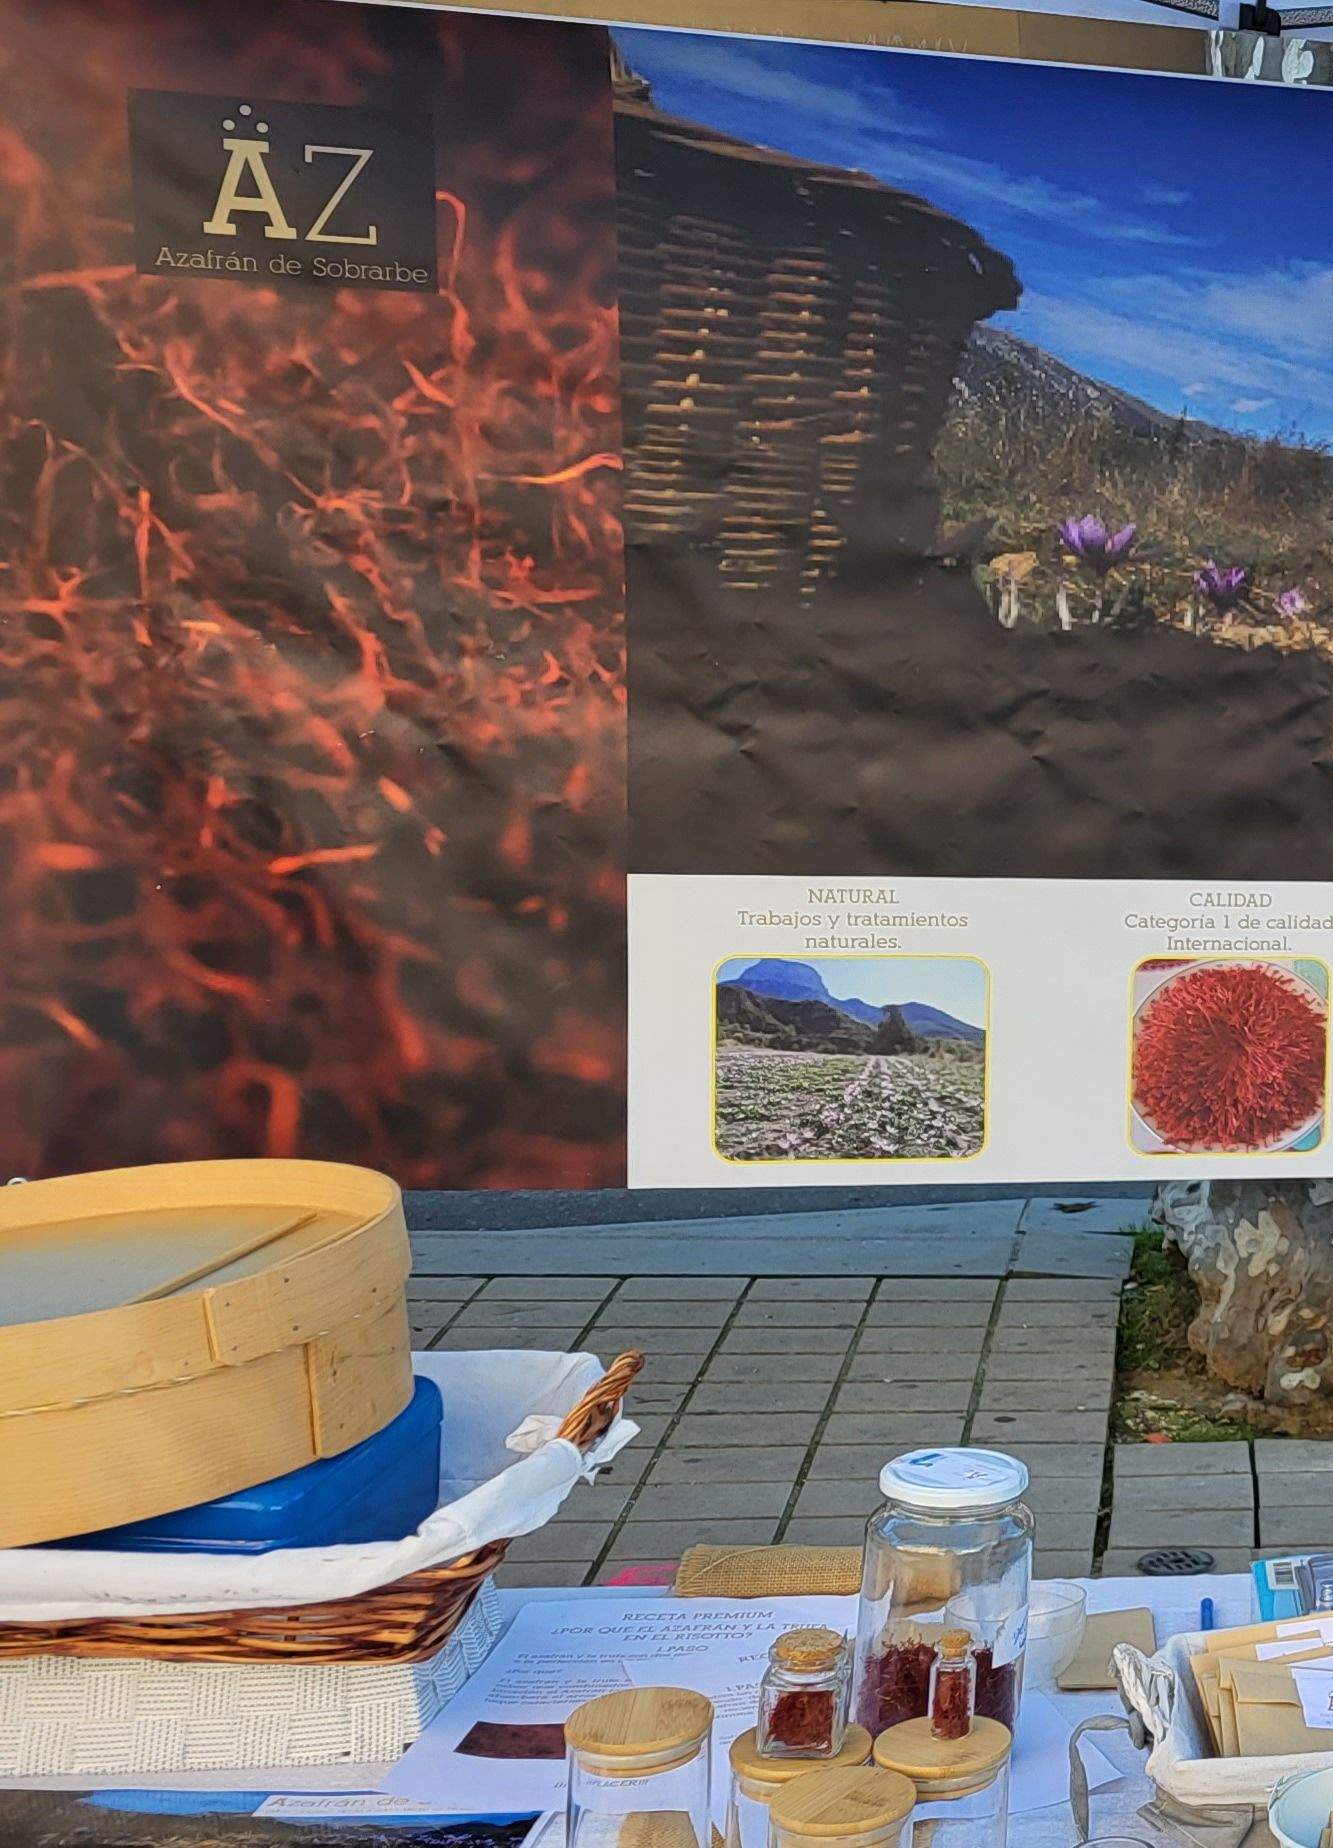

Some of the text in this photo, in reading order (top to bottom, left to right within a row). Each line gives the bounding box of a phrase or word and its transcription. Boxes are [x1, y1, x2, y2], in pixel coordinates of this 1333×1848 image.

[154, 247, 429, 284] Azafrán de Sobrarbe
[807, 888, 900, 904] NATURAL
[1189, 892, 1273, 908] CALIDAD
[737, 910, 969, 930] Trabajos y tratamientos
[1223, 915, 1231, 929] 1
[1237, 915, 1261, 930] de
[805, 933, 902, 949] naturales.
[1167, 936, 1293, 952] Internacional.
[622, 1610, 774, 1622] RECETA PREMIUM
